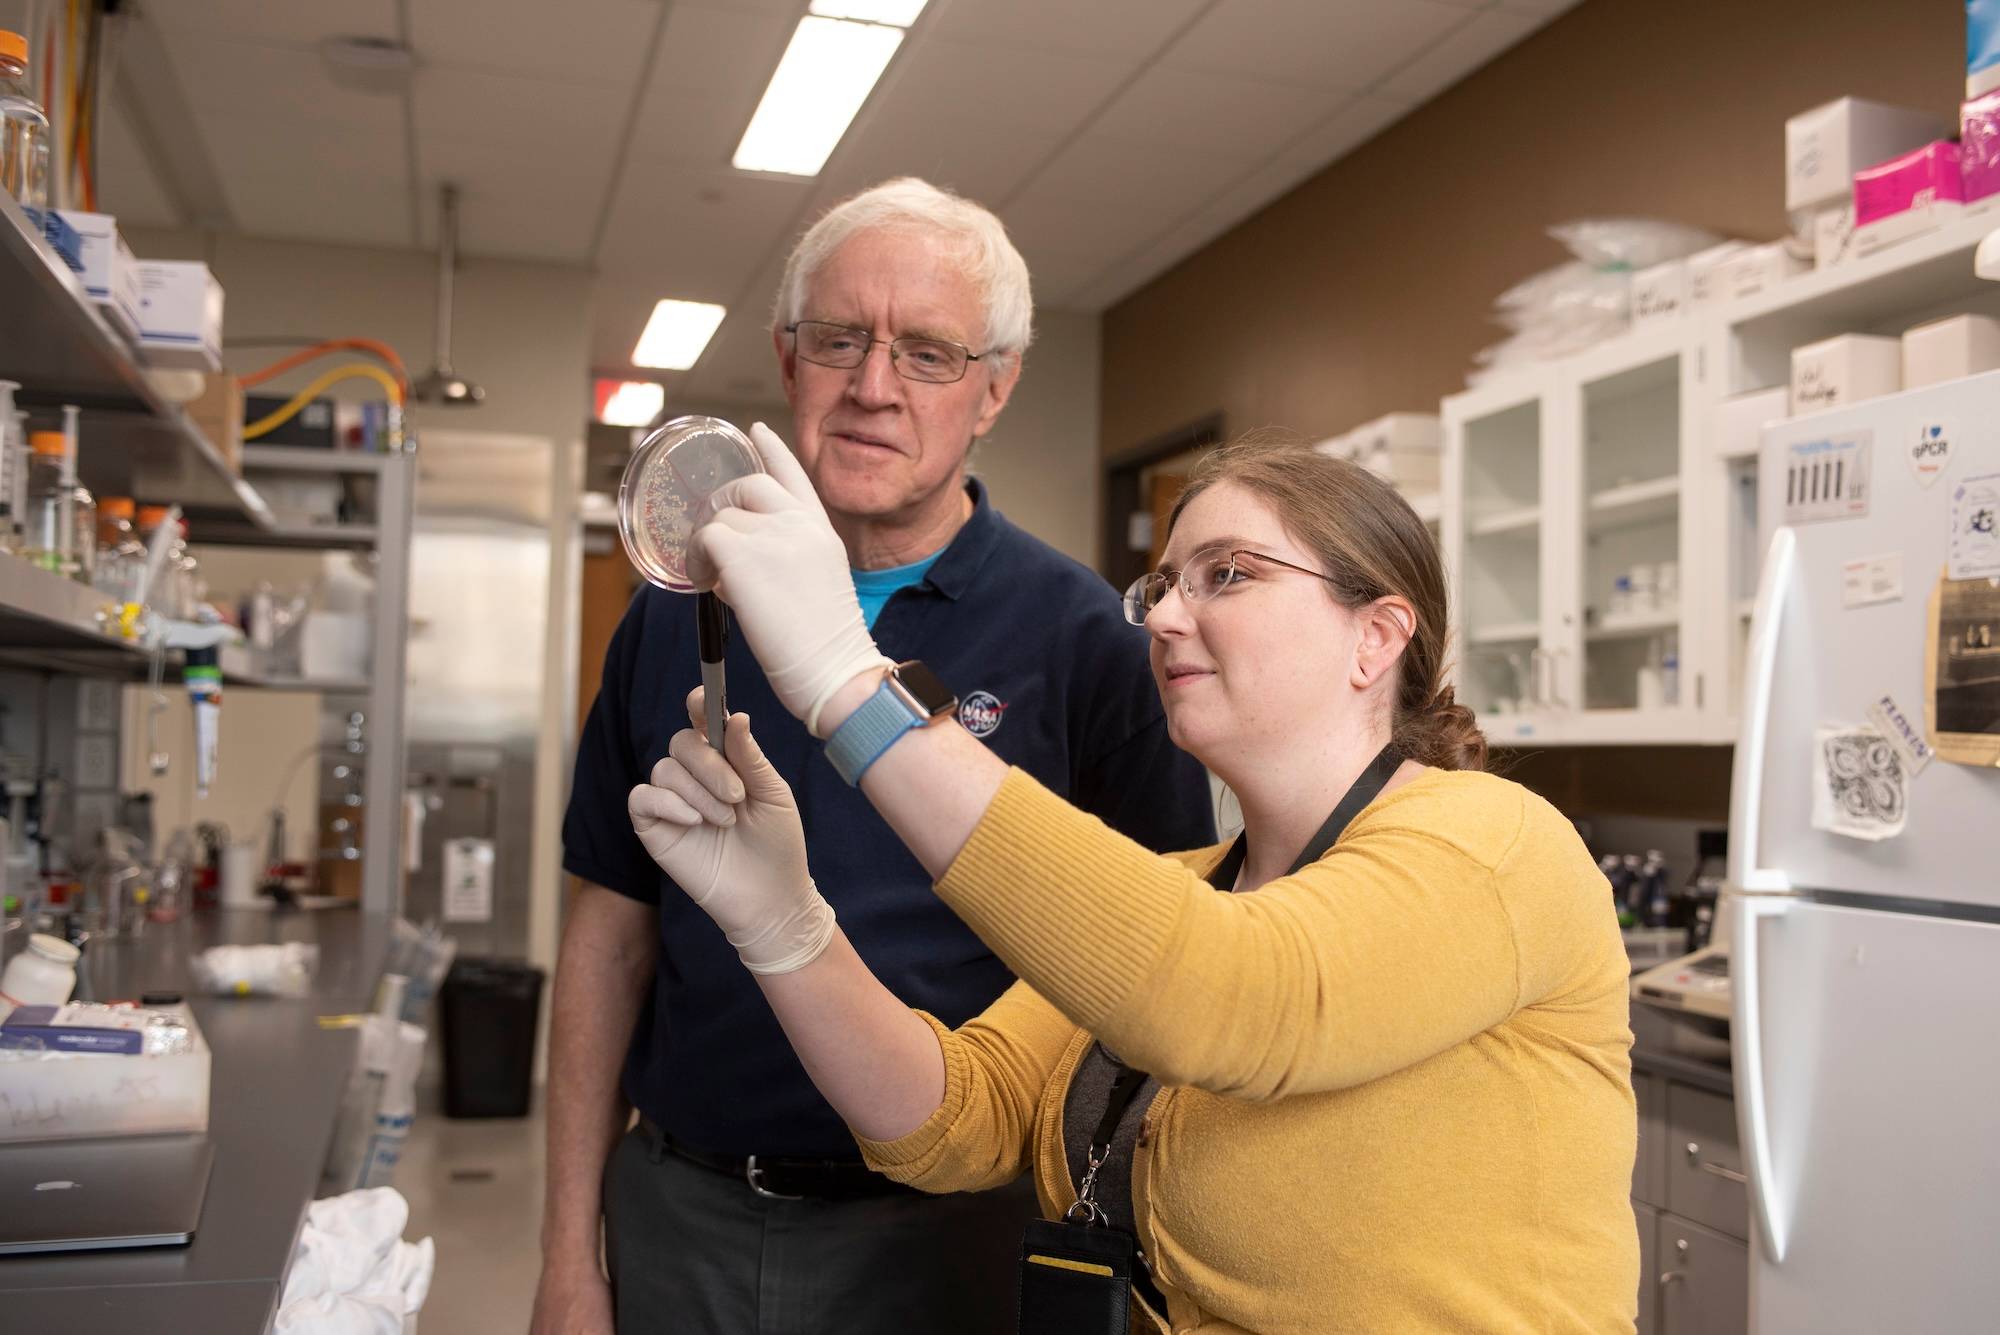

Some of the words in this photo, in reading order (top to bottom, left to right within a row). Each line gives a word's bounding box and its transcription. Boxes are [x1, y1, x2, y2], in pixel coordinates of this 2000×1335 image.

[1912, 441, 1948, 460] qPCR
[963, 704, 997, 723] NASA
[1880, 696, 1926, 758] FLOXIN
